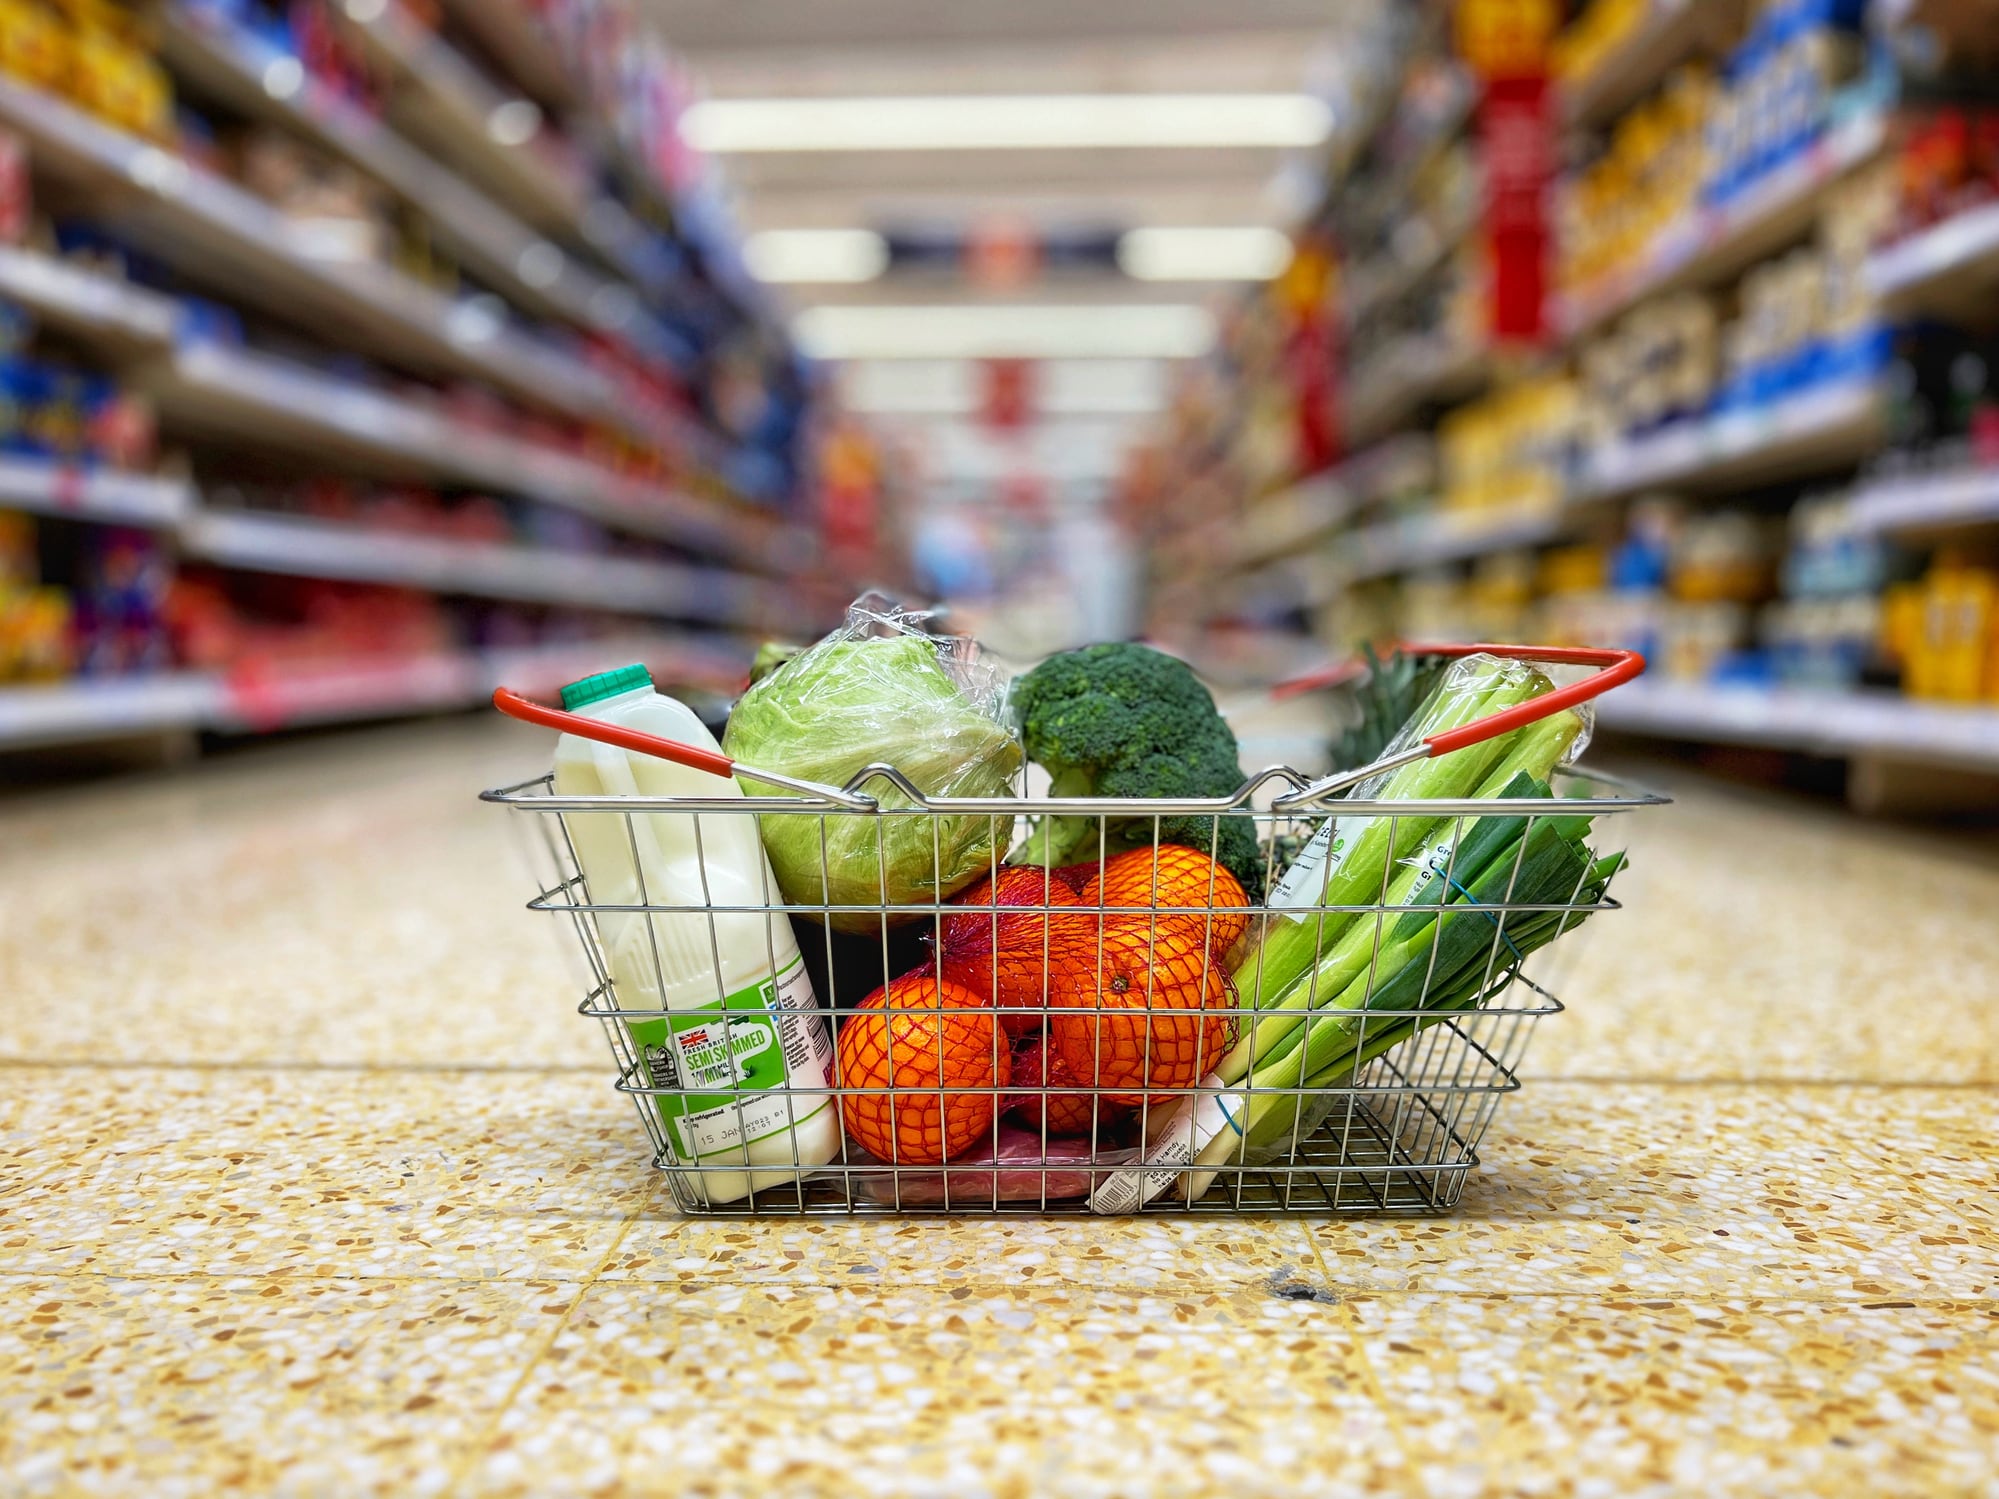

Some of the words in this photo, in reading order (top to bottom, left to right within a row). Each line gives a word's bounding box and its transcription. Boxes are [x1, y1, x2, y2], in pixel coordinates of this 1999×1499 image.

[708, 1033, 738, 1048] BRITH
[686, 1049, 714, 1071] SEMI
[713, 1029, 766, 1062] SKMMED
[701, 1134, 715, 1146] 15
